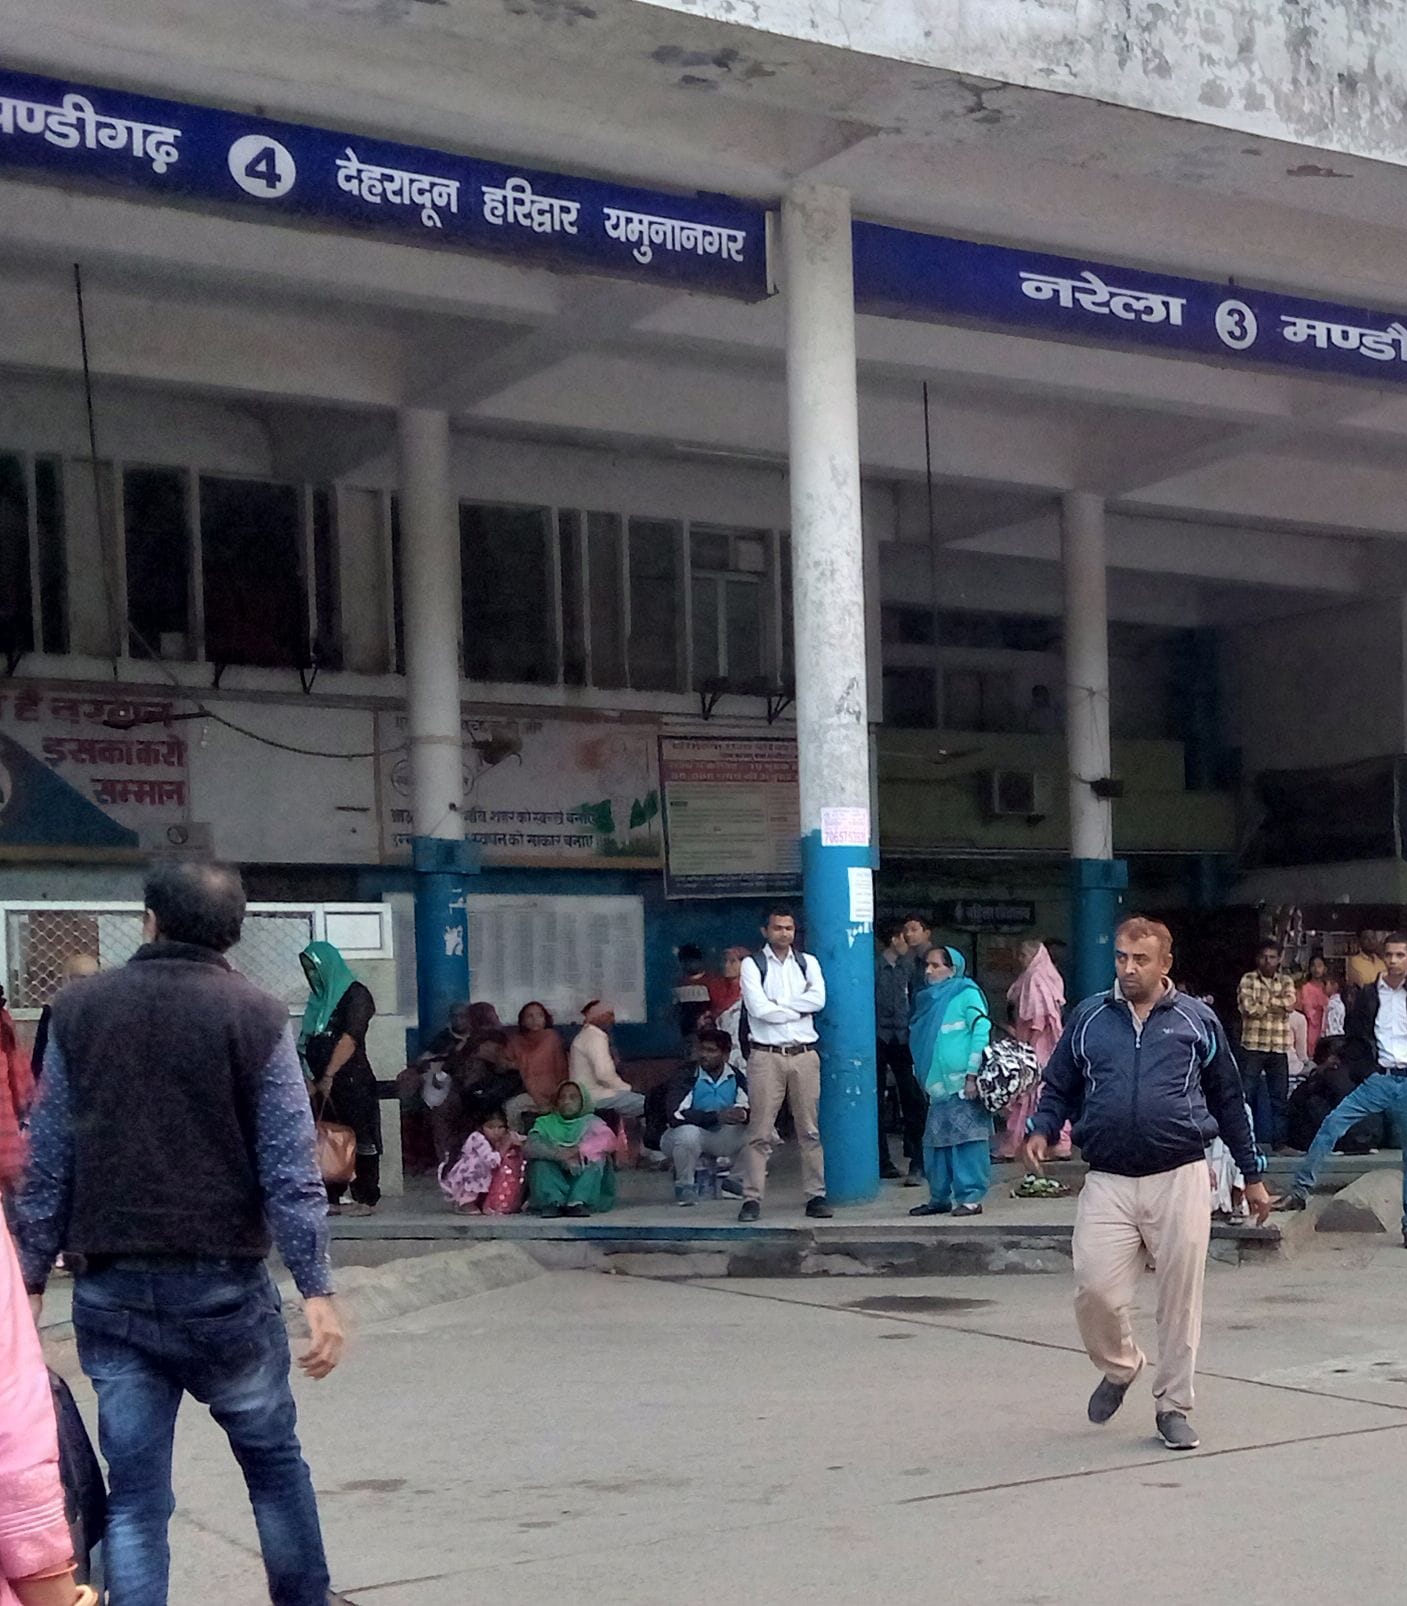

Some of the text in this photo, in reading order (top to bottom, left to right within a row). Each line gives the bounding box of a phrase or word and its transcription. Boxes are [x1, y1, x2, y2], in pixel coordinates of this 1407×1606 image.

[245, 146, 281, 189] 4
[336, 148, 460, 228] देहरादून
[482, 178, 580, 235] हरिद्वार
[603, 208, 746, 264] यमुनानगर
[1019, 271, 1187, 326] नरेला
[1227, 308, 1248, 341] 3
